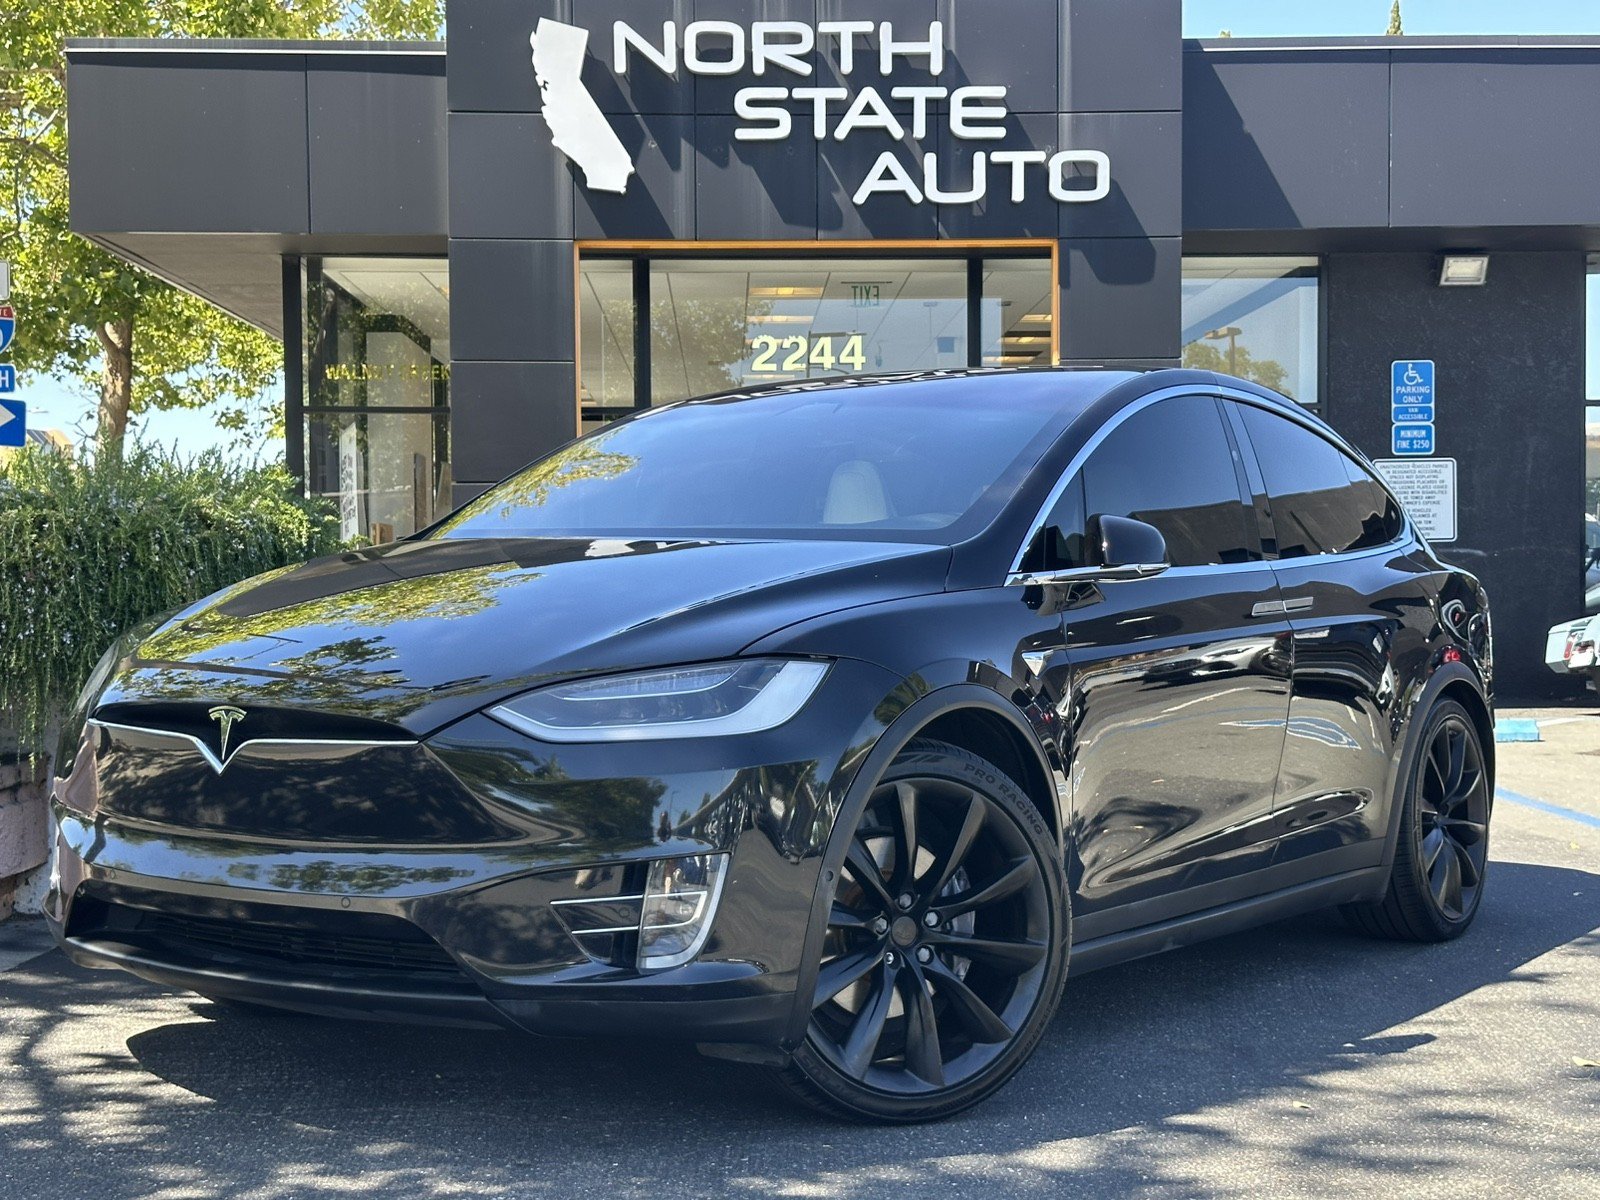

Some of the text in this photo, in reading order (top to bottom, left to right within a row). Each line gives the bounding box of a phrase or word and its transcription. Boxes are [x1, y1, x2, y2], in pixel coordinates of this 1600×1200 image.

[613, 20, 943, 76] NORTH
[734, 86, 1007, 141] STATE
[852, 150, 1110, 206] AUTO
[751, 334, 867, 371] 2244
[1395, 385, 1430, 394] PARKING
[1402, 395, 1423, 403] ONLY
[1396, 439, 1430, 449] FINE $250
[1400, 429, 1426, 438] MINIMUM
[963, 763, 1043, 835] PRO RACING
